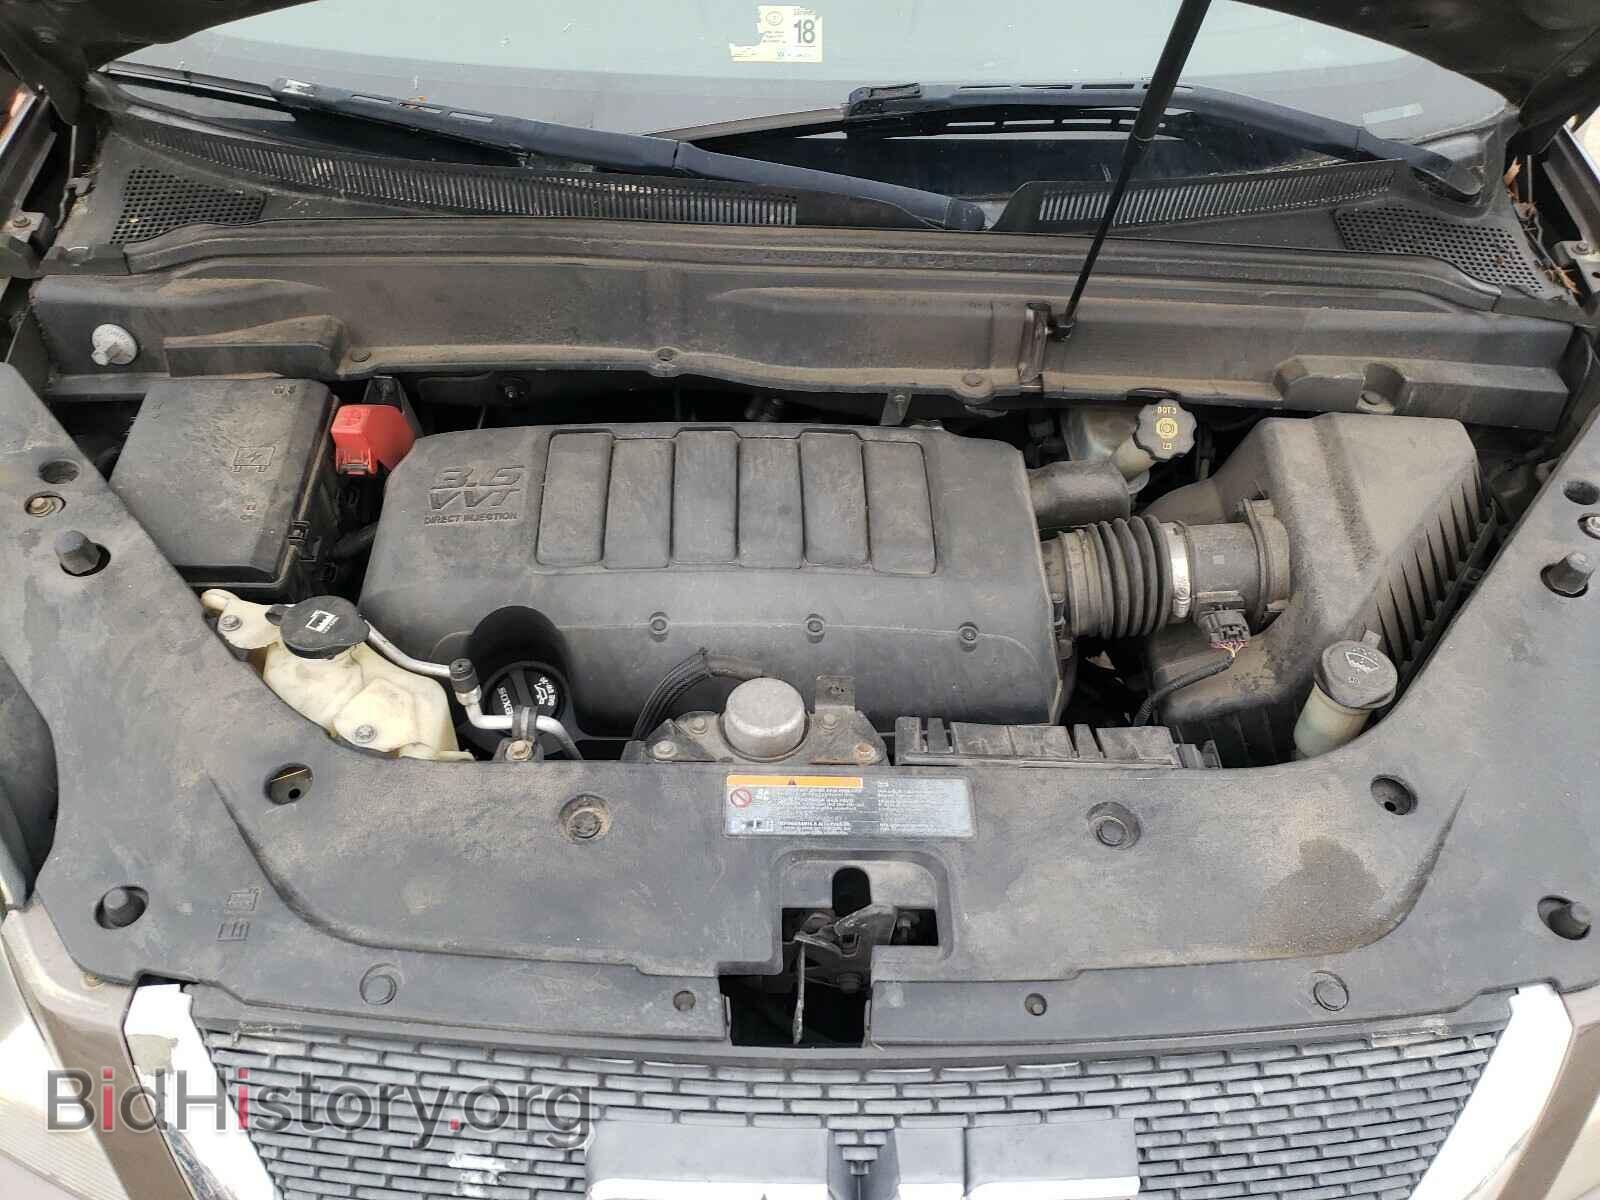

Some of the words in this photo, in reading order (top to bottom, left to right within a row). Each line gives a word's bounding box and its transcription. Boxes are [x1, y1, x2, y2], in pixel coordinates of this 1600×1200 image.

[793, 19, 816, 44] 18
[1157, 406, 1171, 414] DOT
[429, 489, 521, 511] VVT
[424, 514, 462, 525] DIRECT
[463, 511, 519, 522] INJECTION
